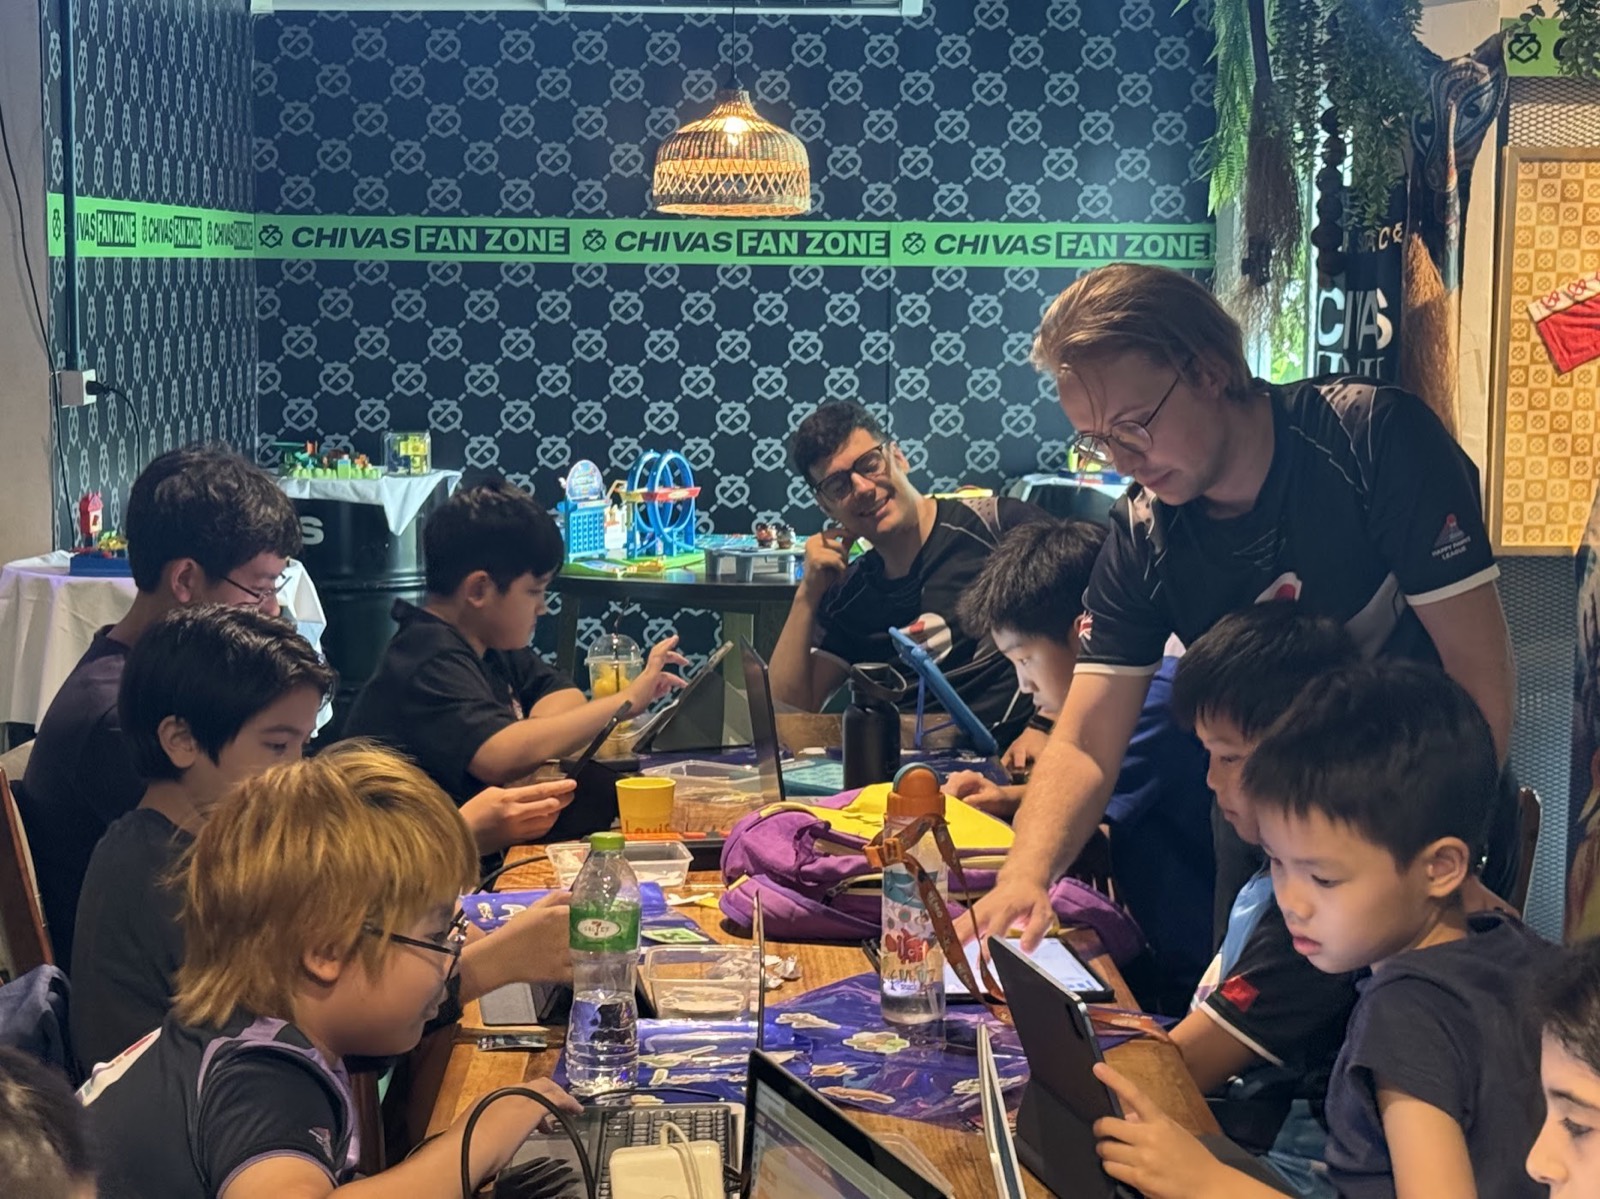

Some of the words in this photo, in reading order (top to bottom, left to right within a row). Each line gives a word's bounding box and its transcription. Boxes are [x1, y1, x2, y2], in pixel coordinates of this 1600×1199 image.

[76, 213, 96, 241] IVAS
[98, 211, 114, 244] FAN
[114, 213, 136, 245] ZONE
[149, 217, 173, 244] CHIVAS
[175, 218, 186, 245] FAN
[186, 219, 202, 246] ZONE
[214, 221, 235, 246] CHIVAS
[291, 227, 411, 249] CHIVAS
[420, 228, 477, 251] FAN
[485, 229, 566, 252] ZONE
[614, 231, 734, 253] CHIVAS
[742, 231, 798, 254] FAN
[805, 232, 886, 255] ZONE
[933, 234, 1053, 256] CHIVAS
[1060, 234, 1117, 257] FAN
[1125, 235, 1205, 258] ZONE
